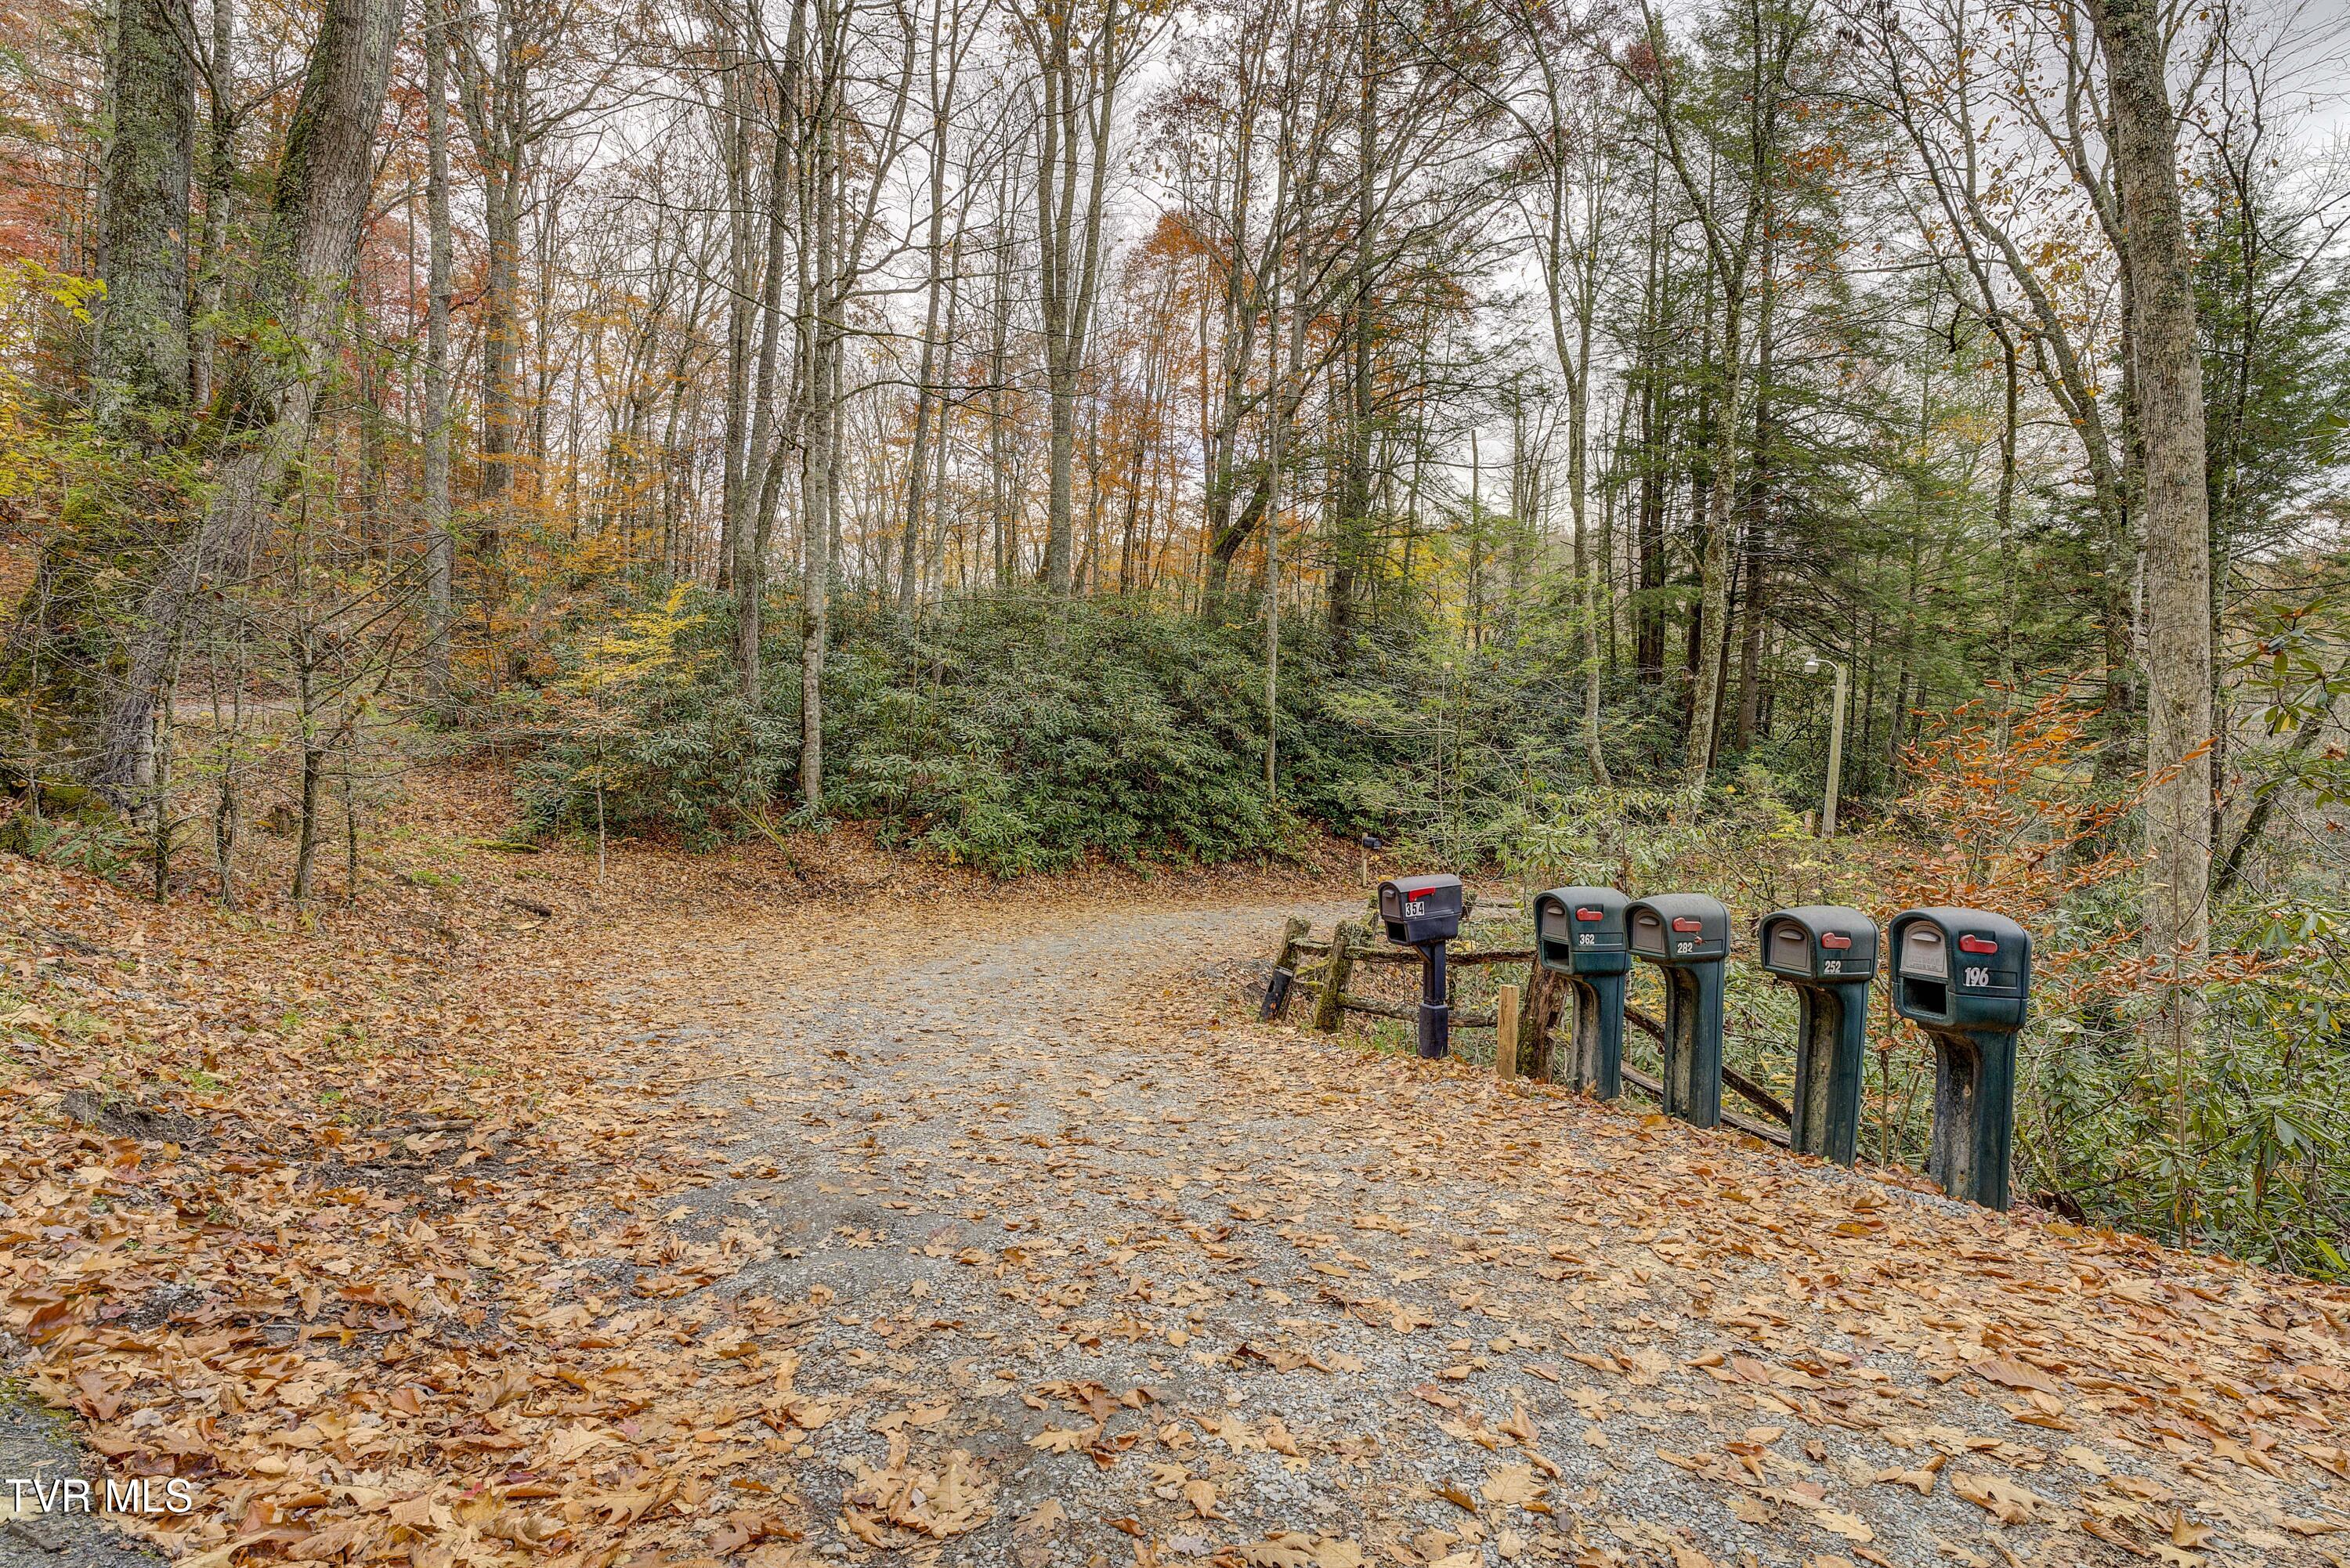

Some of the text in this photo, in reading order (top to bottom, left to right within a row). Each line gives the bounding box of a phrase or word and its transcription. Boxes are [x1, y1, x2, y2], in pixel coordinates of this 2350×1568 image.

[1406, 902, 1424, 916] 354
[1579, 934, 1595, 945] 362
[1677, 941, 1693, 954] 282
[1824, 960, 1842, 974] 252
[1965, 966, 1989, 987] 196
